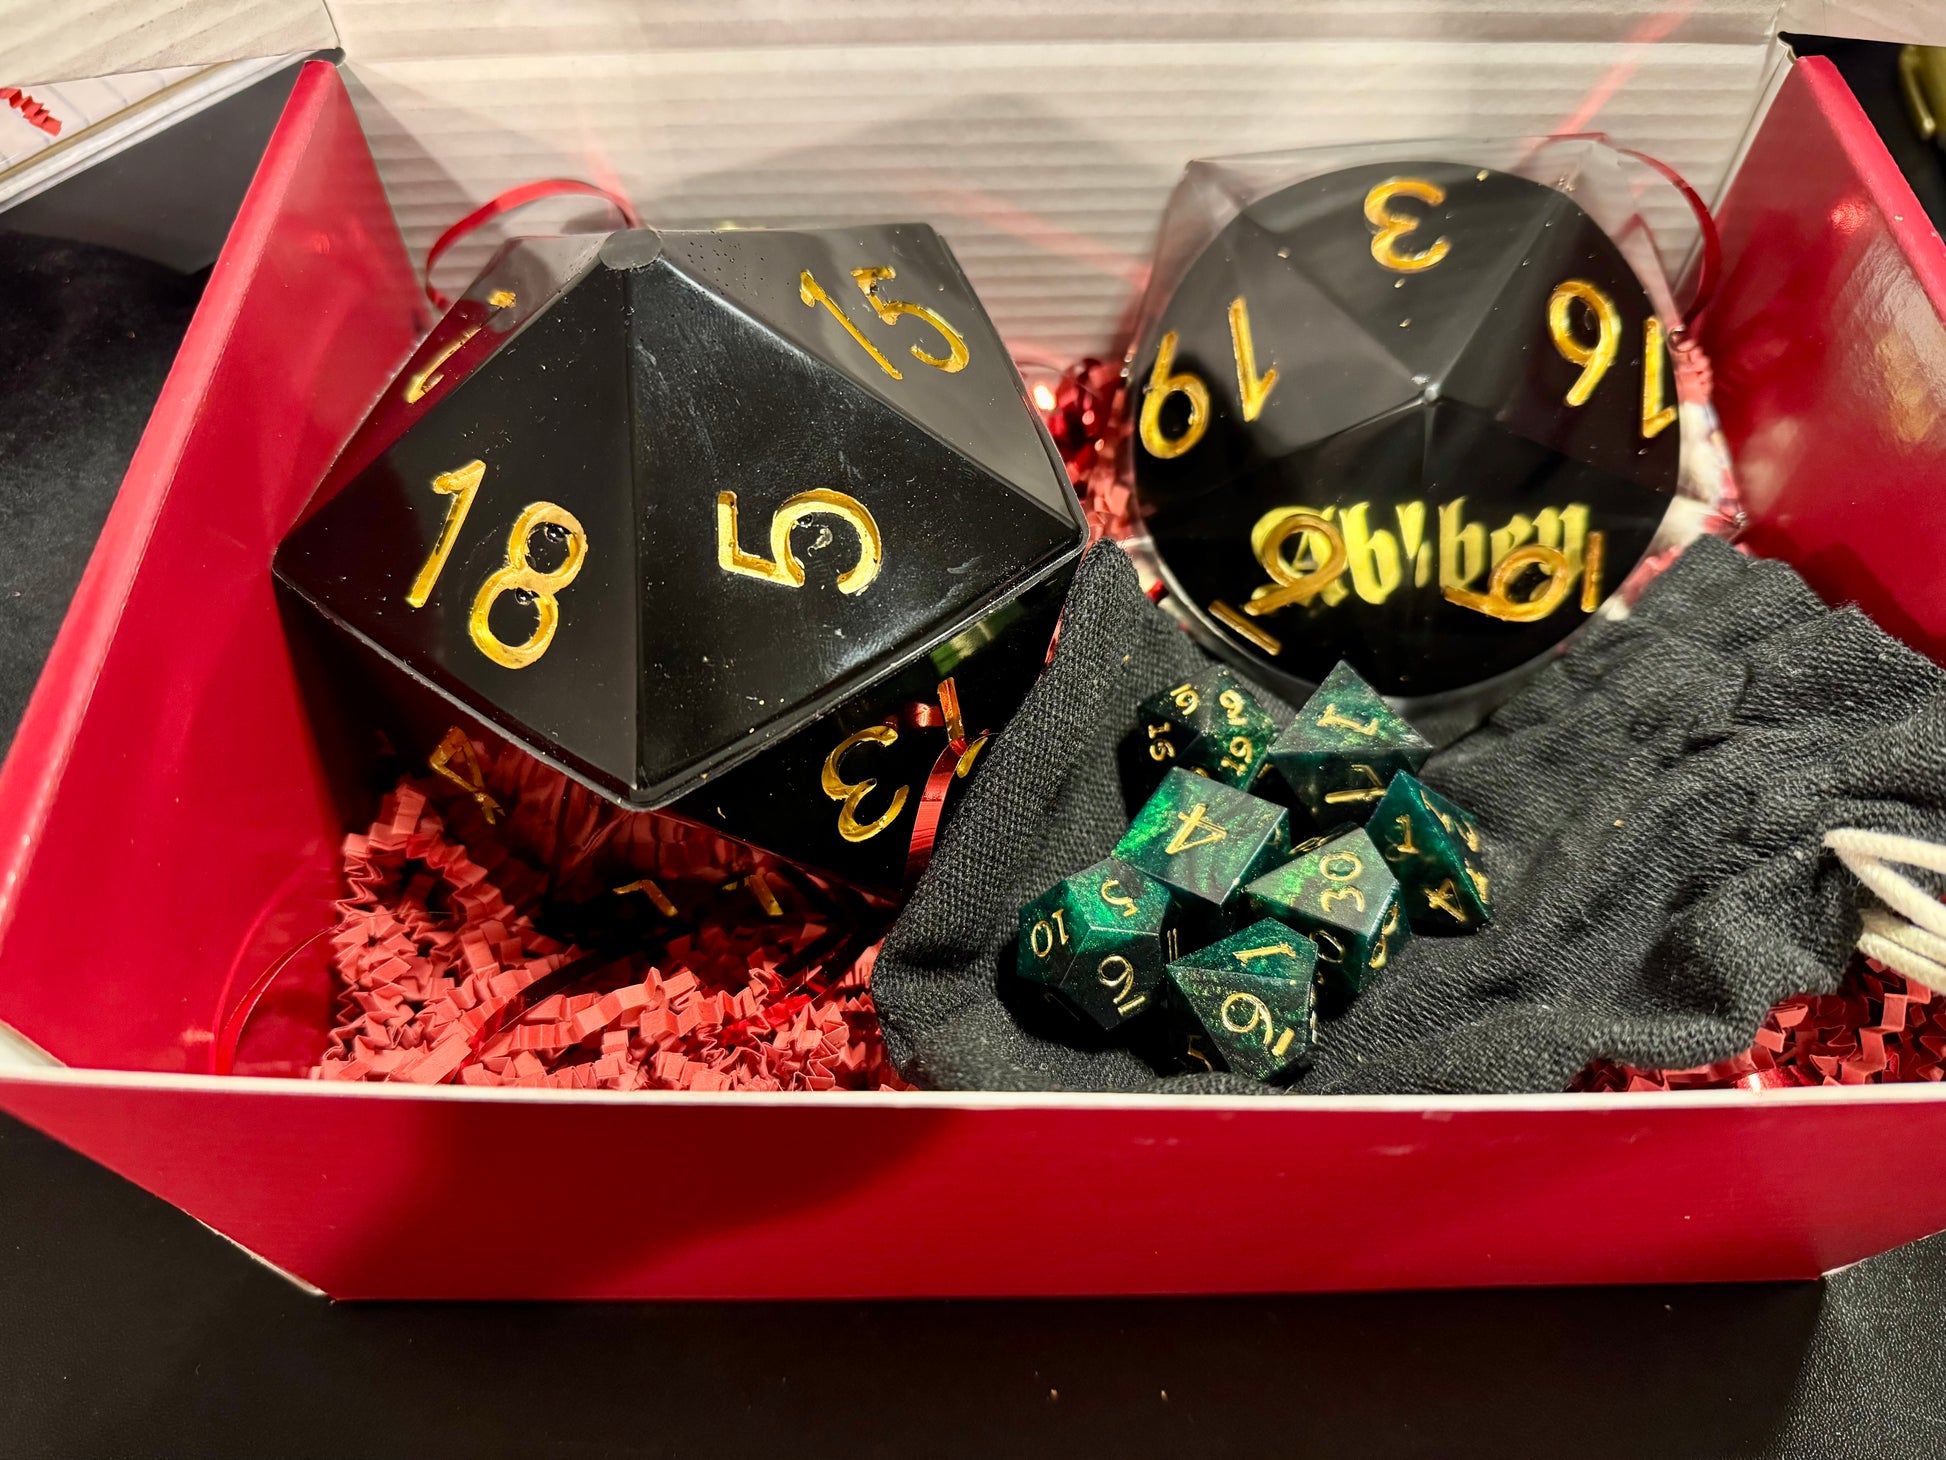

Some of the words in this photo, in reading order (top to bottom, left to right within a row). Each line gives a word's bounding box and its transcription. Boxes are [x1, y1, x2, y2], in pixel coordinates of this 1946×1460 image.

[1364, 178, 1452, 273] 3
[799, 267, 970, 380] 15
[405, 459, 589, 670] 18
[717, 487, 883, 595] 5
[1165, 803, 1227, 855] 4
[1101, 879, 1139, 917] 5
[1319, 851, 1366, 913] 30
[1031, 908, 1069, 958] 10
[1232, 941, 1297, 967] 1
